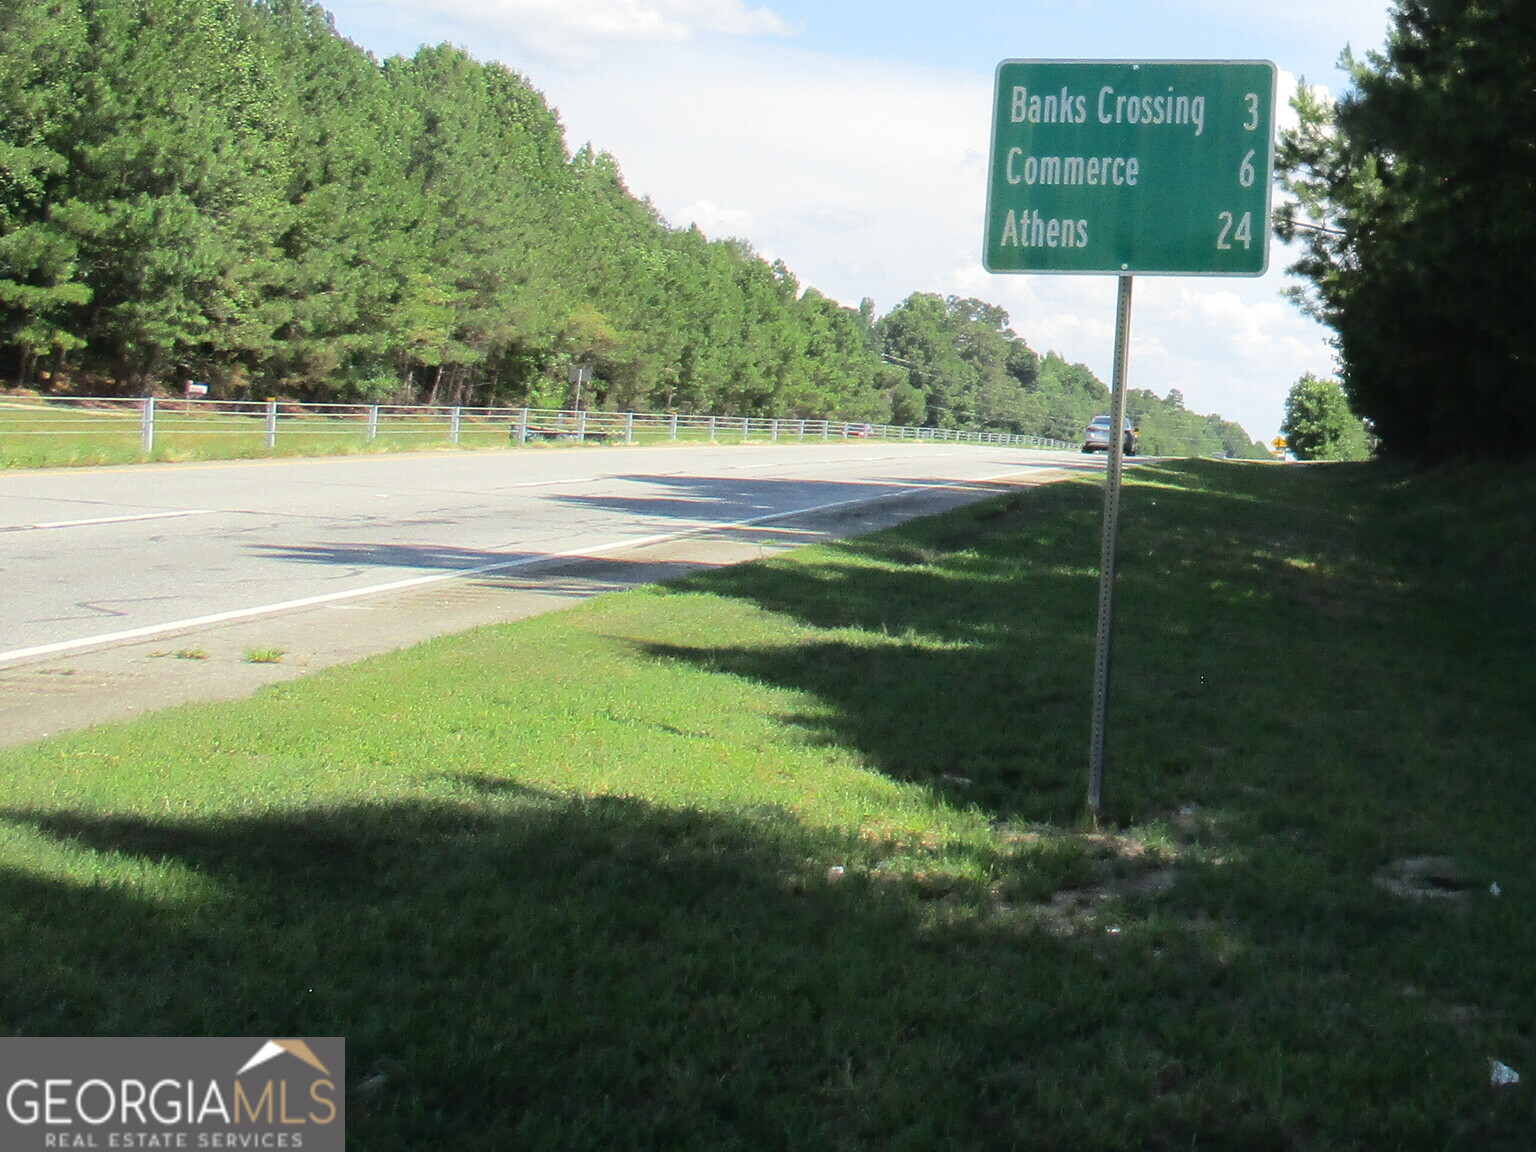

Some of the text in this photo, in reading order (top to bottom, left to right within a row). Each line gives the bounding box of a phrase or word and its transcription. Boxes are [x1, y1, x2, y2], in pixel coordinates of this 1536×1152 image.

[1010, 86, 1259, 136] Banks Crossing 3
[1006, 147, 1255, 187] Commerce 6
[1001, 209, 1252, 250] Athens 24
